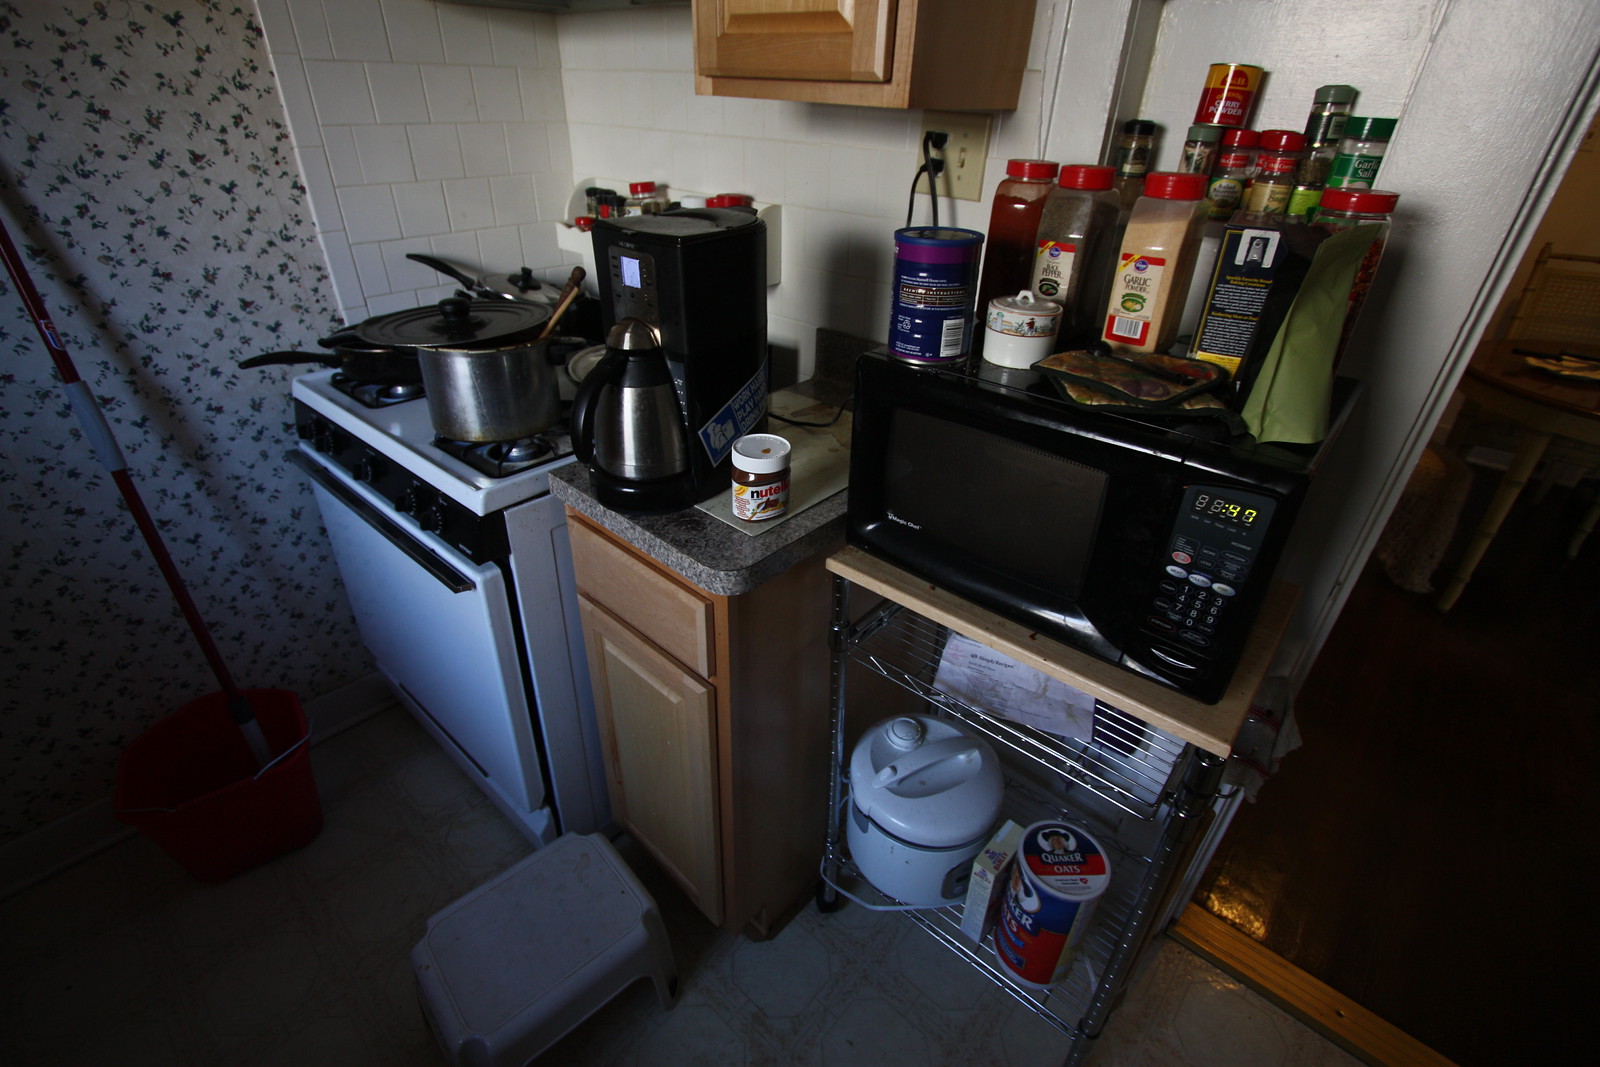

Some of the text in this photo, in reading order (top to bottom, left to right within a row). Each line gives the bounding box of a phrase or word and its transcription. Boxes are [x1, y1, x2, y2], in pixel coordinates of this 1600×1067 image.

[1215, 100, 1242, 108] CRRY
[1208, 106, 1243, 116] POWDER
[1356, 168, 1374, 178] Salt
[1041, 267, 1062, 279] PEPPER
[1123, 273, 1152, 287] GARLIC
[903, 287, 926, 295] BREWI
[1124, 283, 1148, 293] POWDER
[732, 387, 752, 411] WORK
[737, 399, 756, 421] PLAY
[1179, 594, 1186, 602] 4
[1199, 591, 1206, 599] 2
[1195, 600, 1201, 608] 5
[1215, 597, 1222, 606] 3
[1175, 603, 1182, 611] 7
[1210, 607, 1217, 615] 6
[1190, 609, 1198, 618] 8
[1185, 618, 1193, 627] 0
[1206, 616, 1214, 624] 9
[1041, 851, 1084, 865] QUAKER
[1053, 864, 1081, 874] OATS
[1009, 897, 1034, 932] KER
